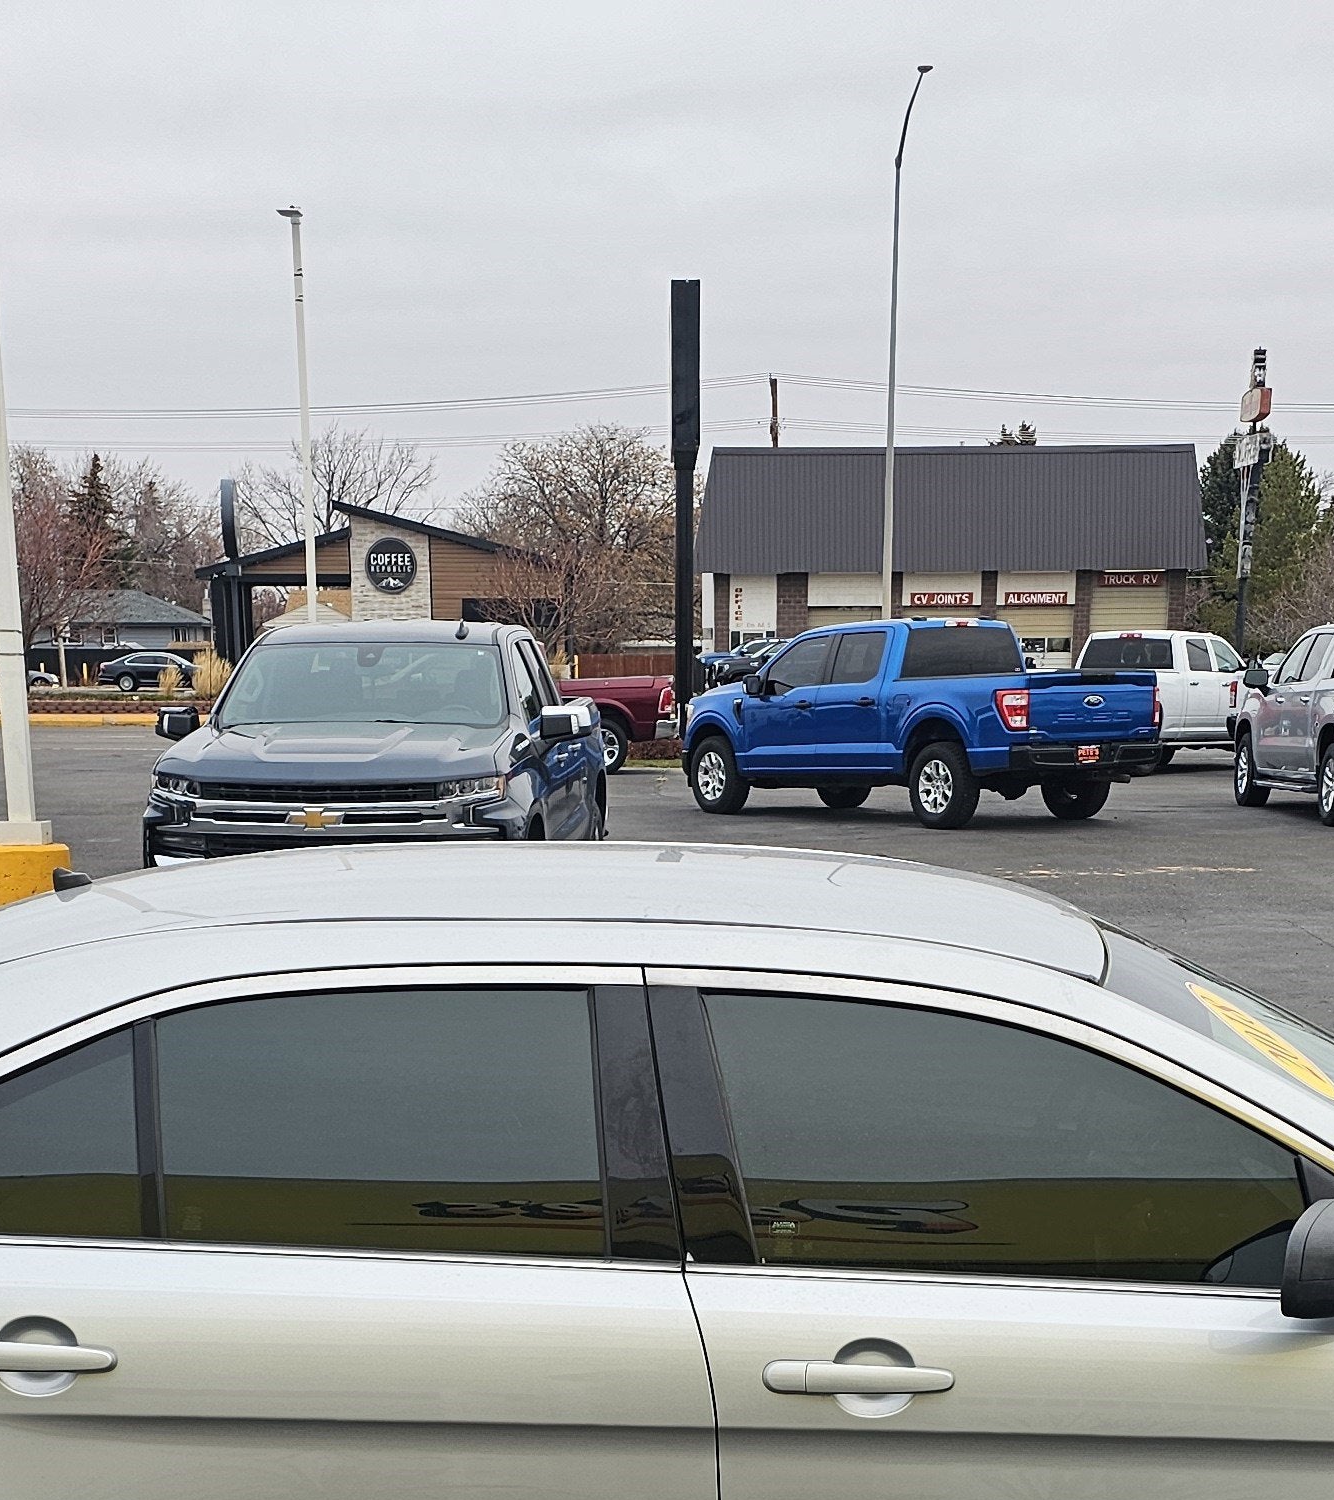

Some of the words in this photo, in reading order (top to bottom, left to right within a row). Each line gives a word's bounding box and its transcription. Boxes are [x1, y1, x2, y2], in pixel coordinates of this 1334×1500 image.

[370, 553, 412, 566] COFFEE
[1104, 574, 1136, 584] TRUCK
[1142, 574, 1159, 584] RV
[913, 594, 928, 605] CV
[930, 594, 970, 605] JOINTS
[1006, 593, 1066, 605] ALIGNMENT
